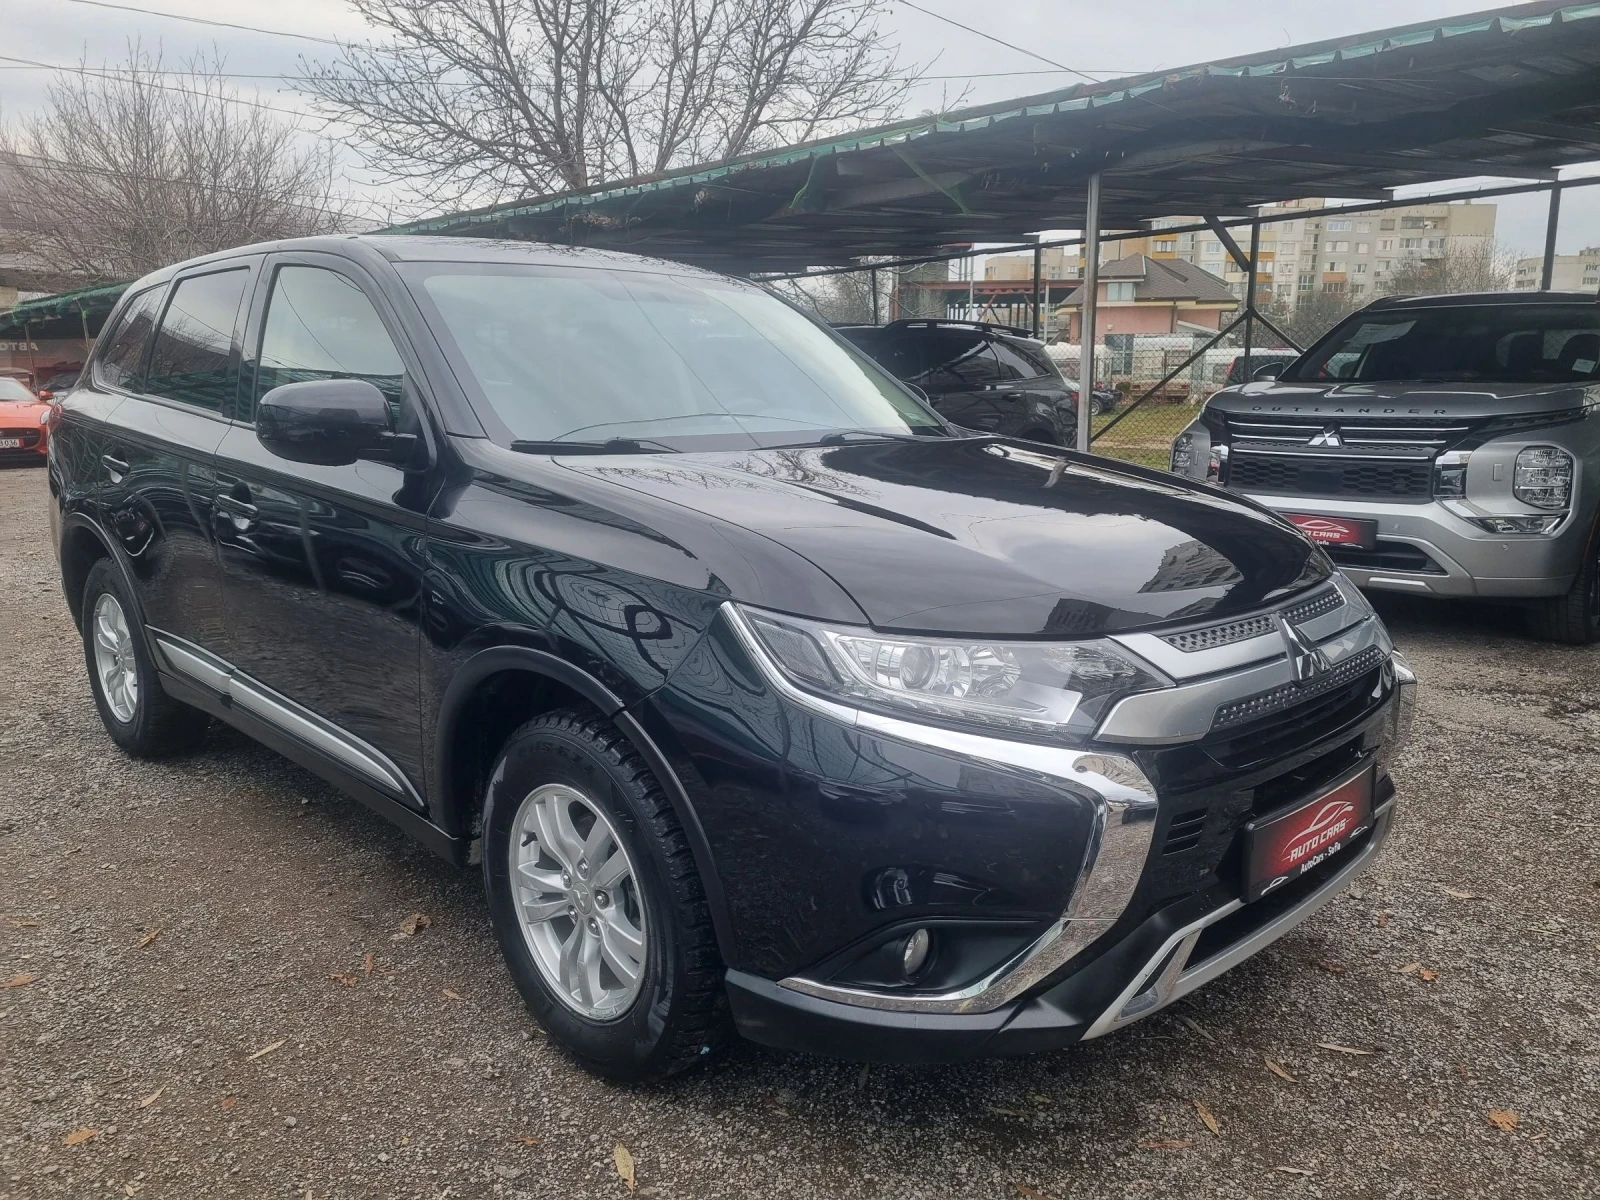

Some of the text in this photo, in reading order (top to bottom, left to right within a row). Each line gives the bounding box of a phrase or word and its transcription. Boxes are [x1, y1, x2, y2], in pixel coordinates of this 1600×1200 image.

[1252, 406, 1446, 415] OUTLANDER
[4, 439, 18, 447] 036
[1313, 531, 1341, 539] CARS
[1290, 818, 1347, 863] AUTO CARS
[1300, 853, 1324, 874] AutoCars
[1328, 841, 1341, 857] Sofia
